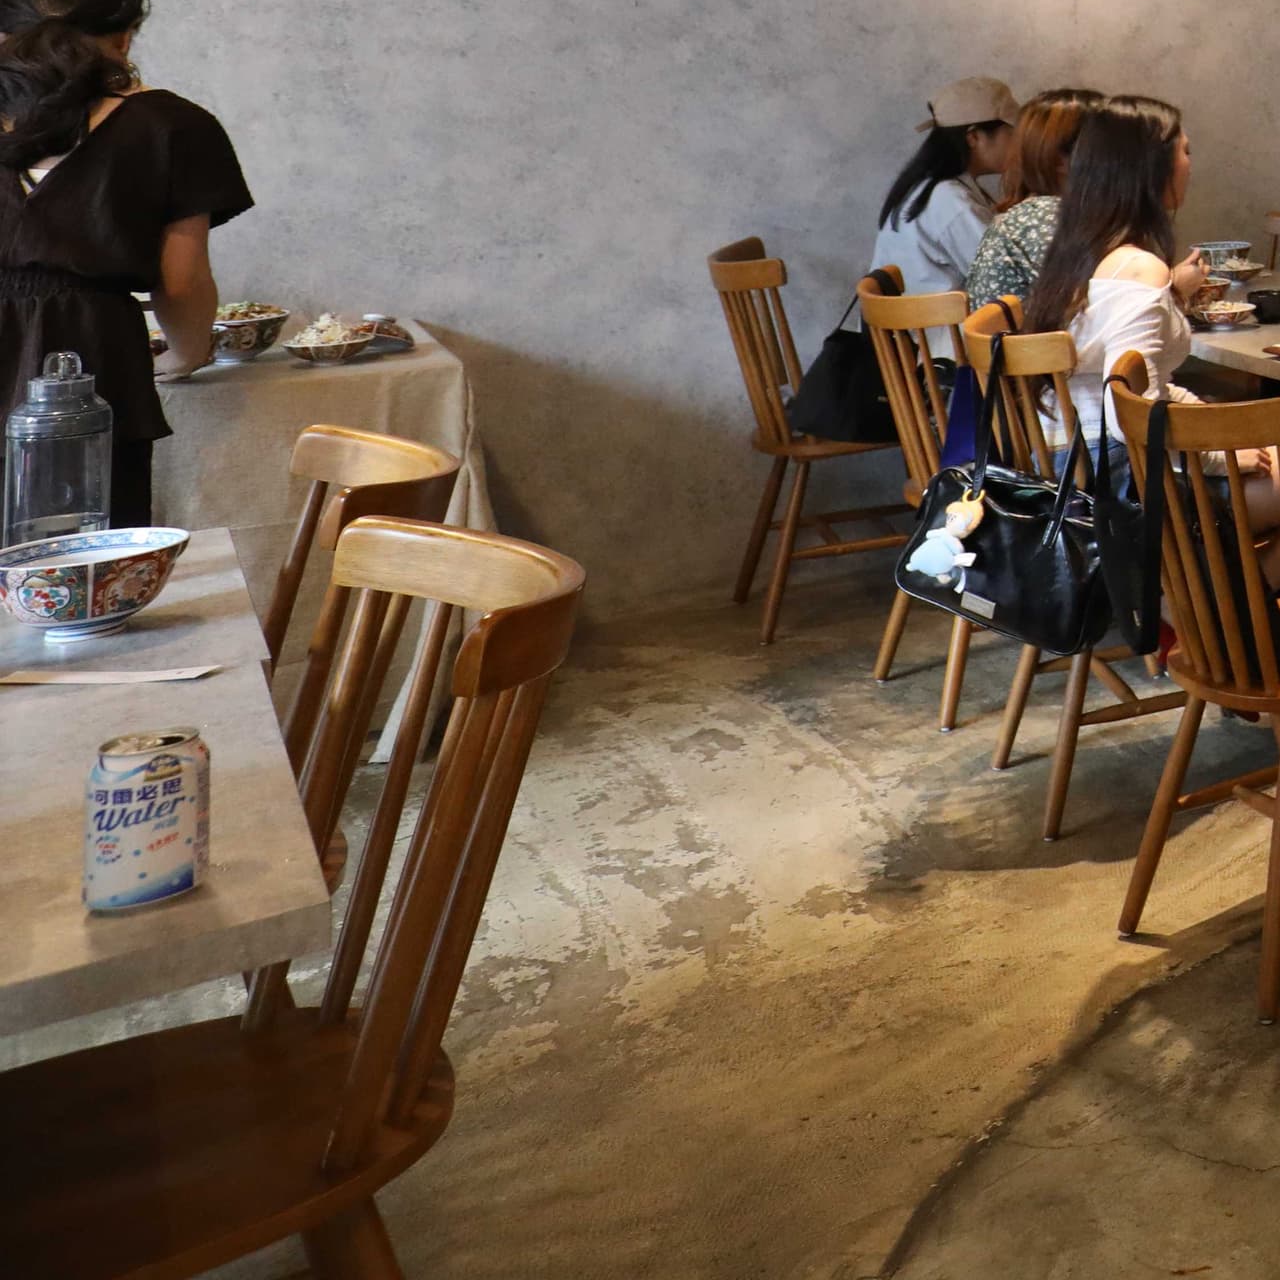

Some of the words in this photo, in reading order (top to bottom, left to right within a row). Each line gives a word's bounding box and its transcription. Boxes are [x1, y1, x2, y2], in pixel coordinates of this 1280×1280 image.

[94, 777, 183, 806] 可爾必思
[93, 795, 187, 832] Water
